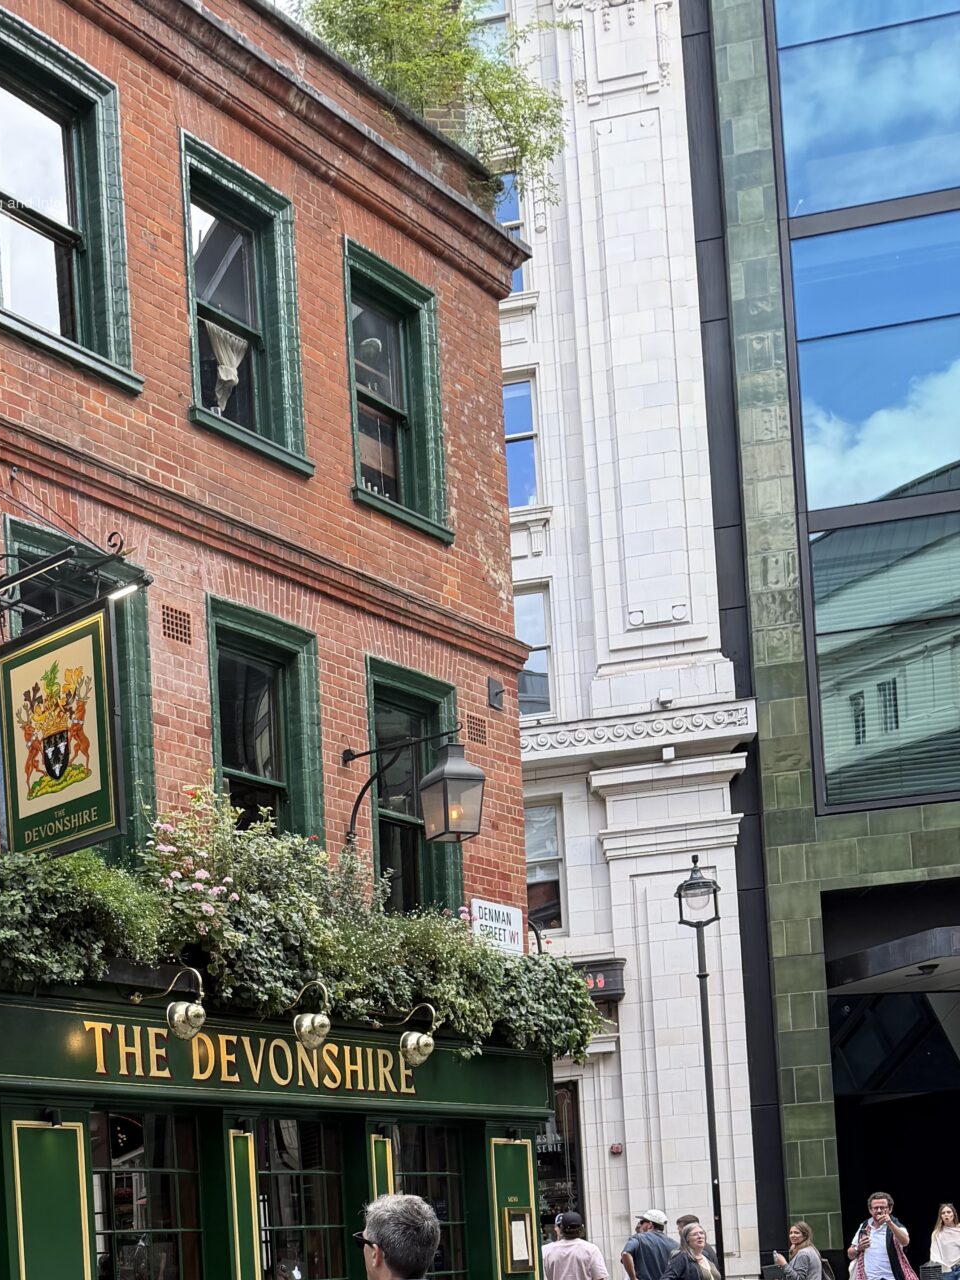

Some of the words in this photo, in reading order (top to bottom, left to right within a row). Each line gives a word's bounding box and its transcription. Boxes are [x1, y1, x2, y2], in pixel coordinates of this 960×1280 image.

[54, 808, 66, 818] THE
[24, 806, 98, 845] DEVONSHIRE
[478, 906, 512, 927] DENMAN
[508, 929, 519, 945] W1
[83, 1020, 173, 1079] THE
[191, 1033, 417, 1095] DEVONSHIRE
